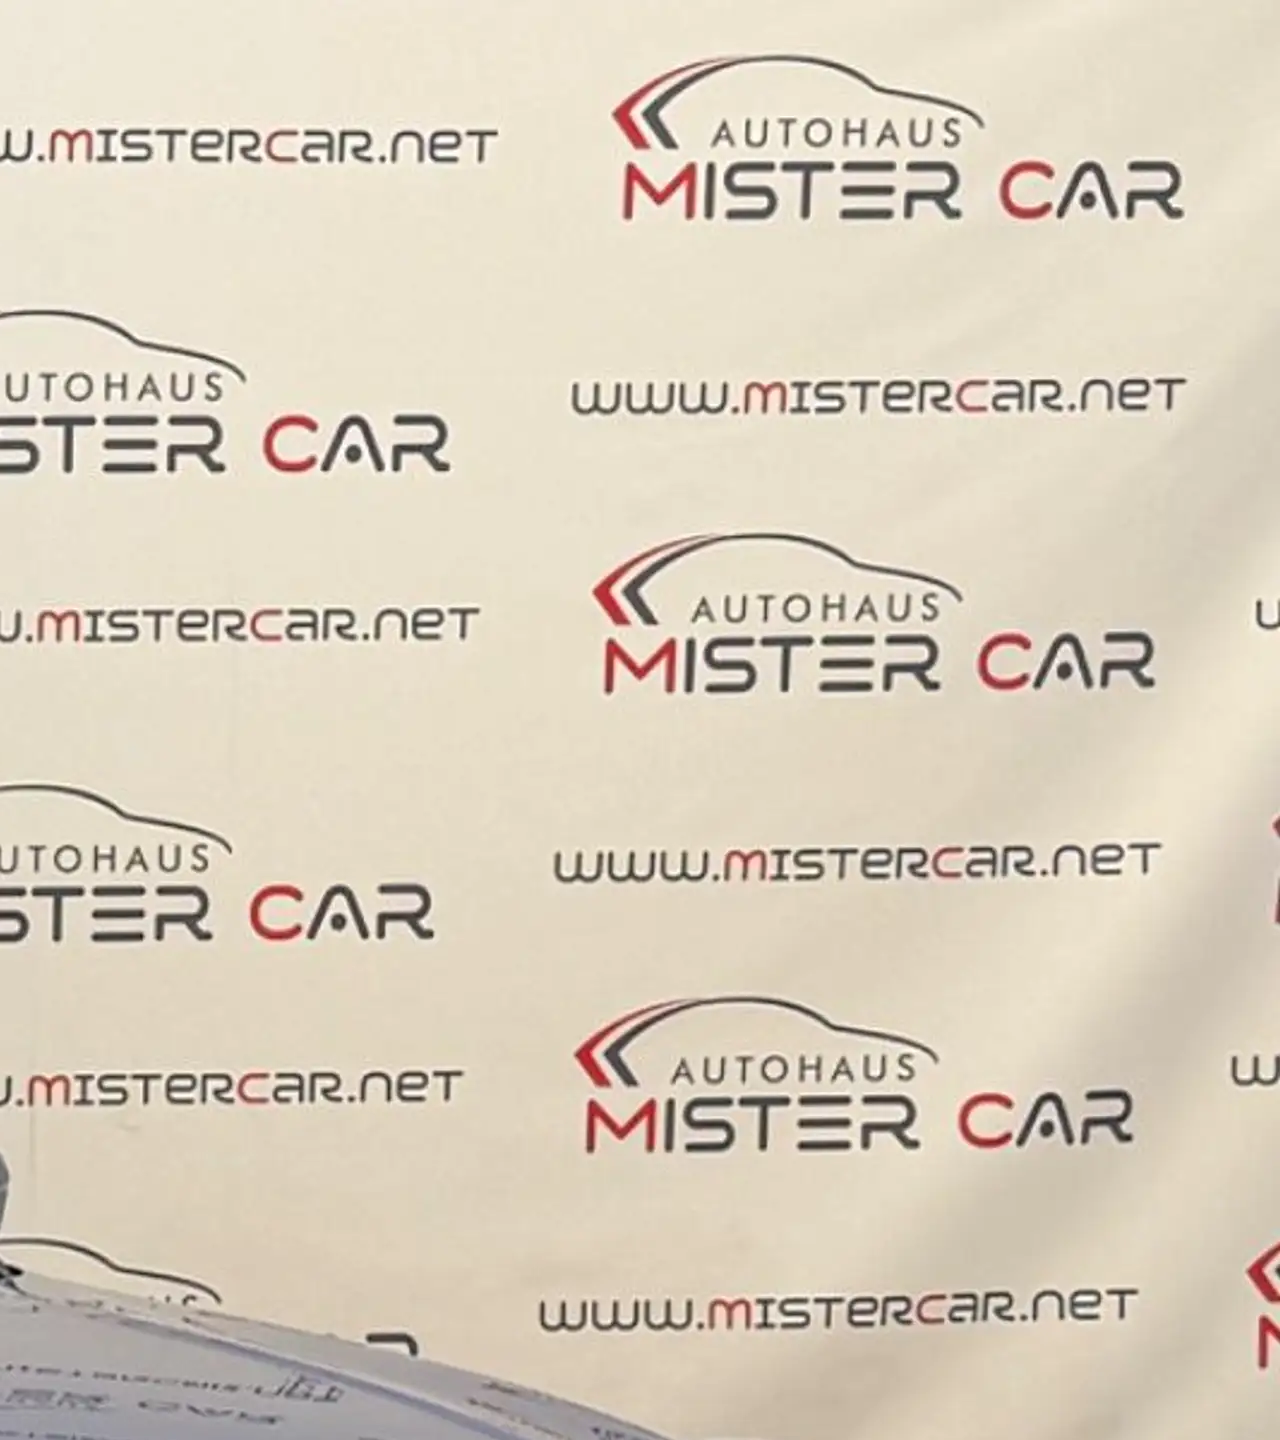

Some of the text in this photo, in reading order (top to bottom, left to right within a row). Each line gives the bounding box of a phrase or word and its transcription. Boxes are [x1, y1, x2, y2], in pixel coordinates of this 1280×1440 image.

[711, 118, 960, 148] AUTOHAUS
[623, 161, 1184, 220] MISTER CAR
[263, 415, 450, 473] CAR
[691, 593, 939, 623] AUTOHAUS
[604, 632, 1155, 695] MISTER CAR
[250, 884, 434, 941] CAR
[671, 1054, 915, 1084] AUTOHAUS
[586, 1090, 1133, 1153] MISTER CAR
